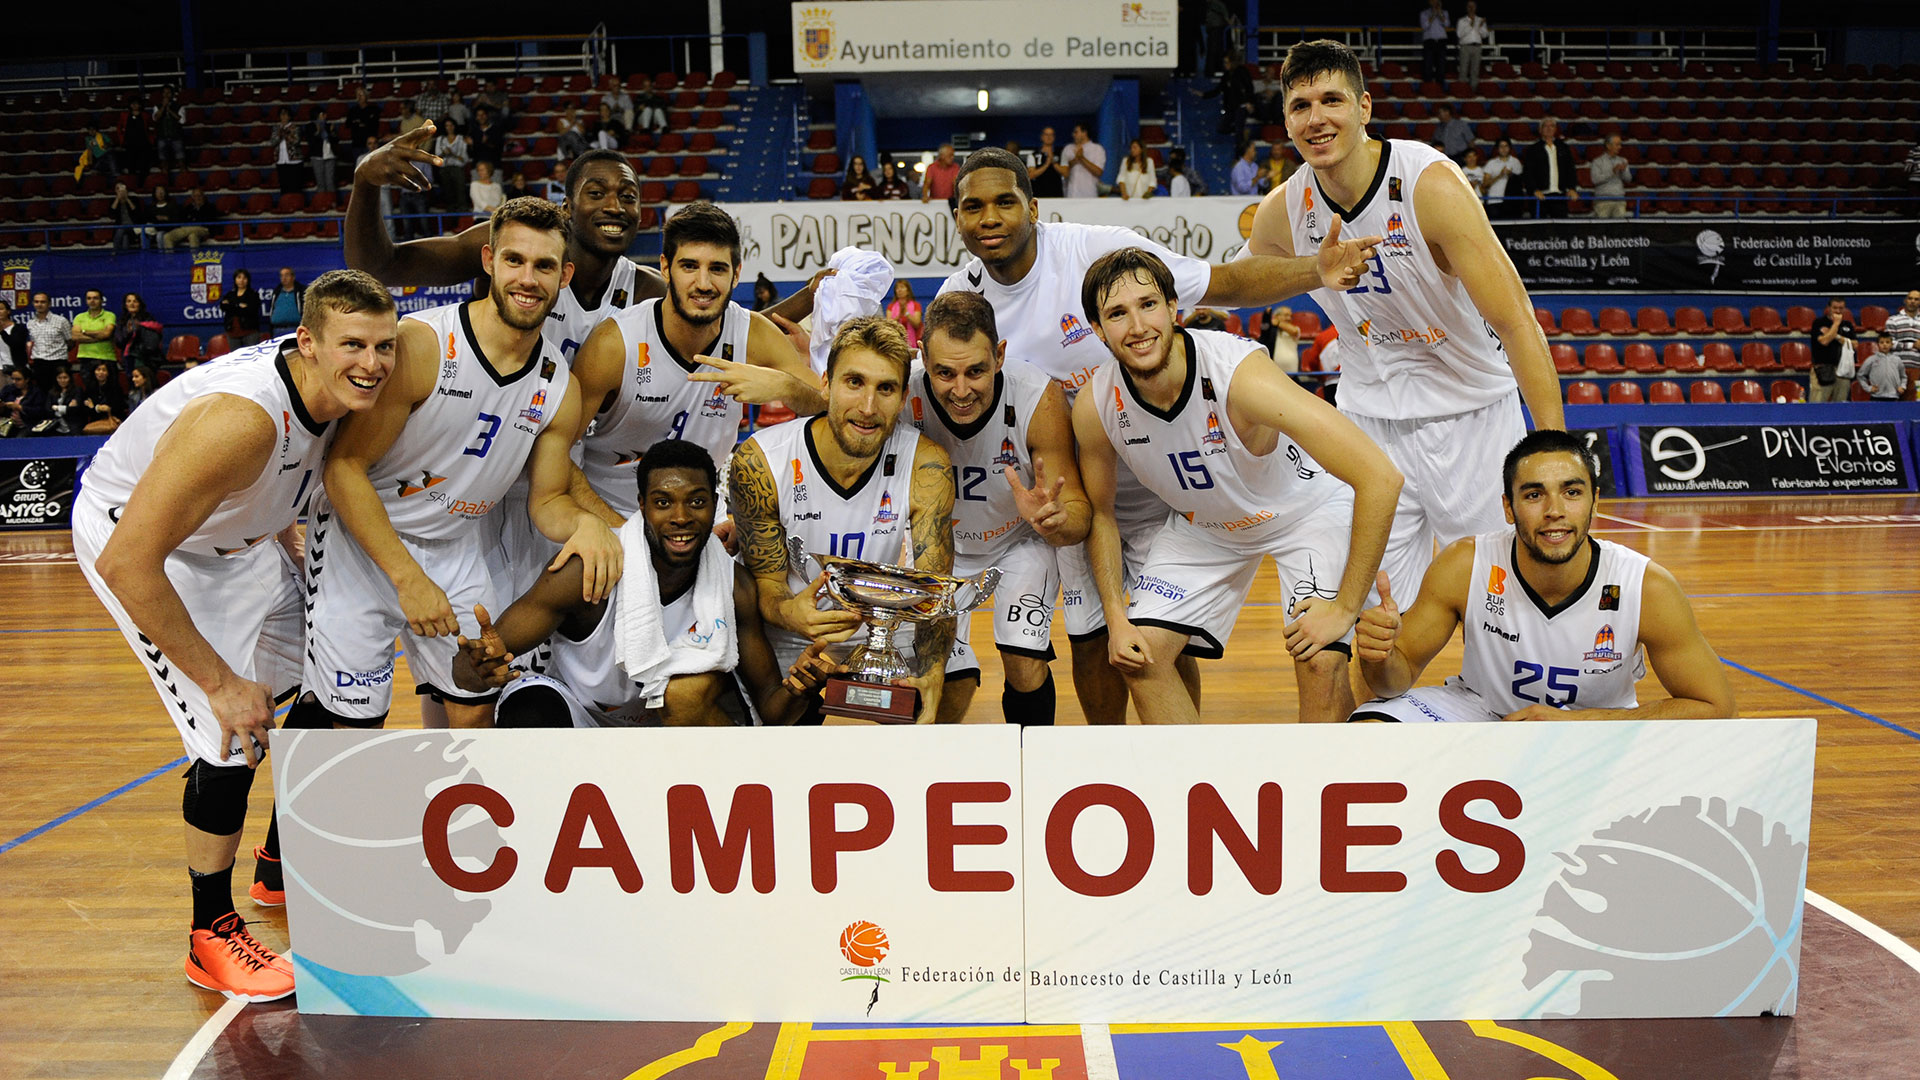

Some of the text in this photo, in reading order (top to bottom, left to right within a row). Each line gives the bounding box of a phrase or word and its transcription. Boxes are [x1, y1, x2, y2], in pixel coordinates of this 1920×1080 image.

[840, 37, 1170, 64] Ayuntamiento de Palencia
[1506, 235, 1650, 250] Federación de Baloncesto
[1733, 235, 1871, 249] Federación de Baloncesto
[1528, 254, 1630, 270] de Castilla y León
[1753, 253, 1852, 268] de Castilla y León
[51, 295, 82, 307] nta
[396, 297, 438, 312] astilla
[437, 385, 473, 399] hummel
[635, 393, 670, 403] hummel
[463, 411, 502, 458] 3
[513, 422, 538, 436] LEXU
[1124, 435, 1151, 445] ummel
[1167, 450, 1214, 490] 15
[952, 466, 987, 501] 12
[1654, 479, 1749, 490] www.diventia.com
[1772, 477, 1898, 490] Fabricando experiencias
[13, 493, 46, 502] GRUPO
[425, 491, 496, 515] SANpabl
[0, 501, 61, 518] AMYGO
[1197, 510, 1273, 531] SANpablo
[829, 532, 866, 560] 10
[1145, 576, 1188, 594] automotor
[1483, 621, 1520, 642] hummel
[1584, 663, 1623, 674] LEXUS
[336, 668, 394, 687] Dursan
[1512, 660, 1579, 708] 25
[331, 693, 370, 705] hummel
[422, 779, 1526, 897] CAMPEONES
[840, 967, 869, 975] CASTILLA
[874, 966, 891, 975] LEÓN
[901, 966, 1293, 989] Federación de Baloncesto de Castilla y León
